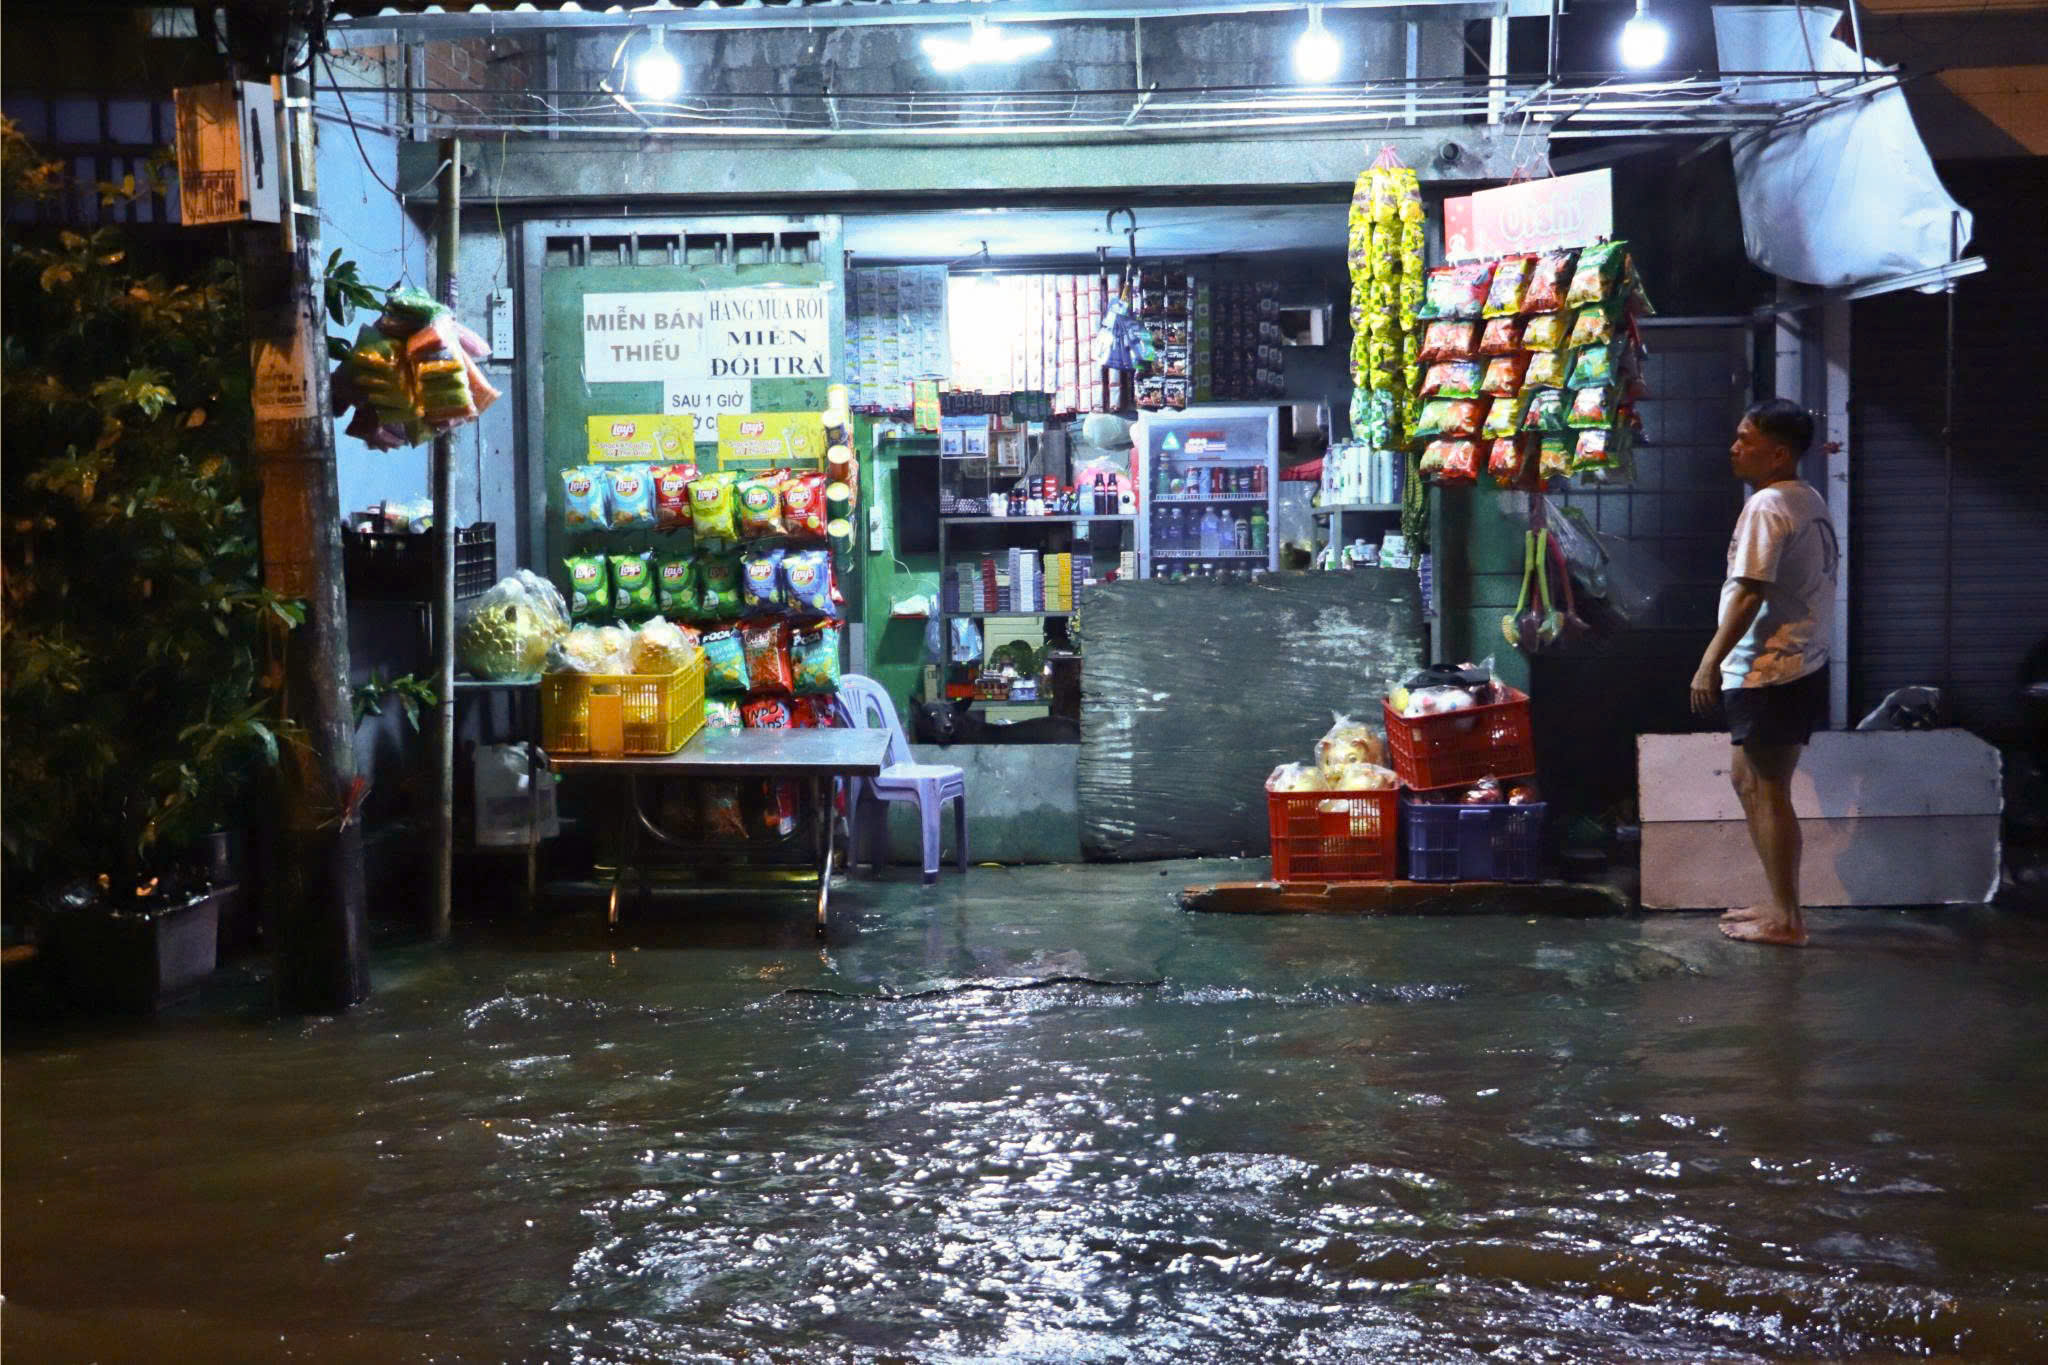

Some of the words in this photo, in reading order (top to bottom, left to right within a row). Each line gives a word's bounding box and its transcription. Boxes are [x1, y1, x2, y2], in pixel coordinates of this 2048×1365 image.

[758, 299, 793, 320] MUA
[585, 305, 646, 331] MIỄN
[654, 307, 704, 330] BÁN
[610, 338, 680, 362] THIẾU
[672, 394, 701, 408] SAU
[705, 394, 712, 408] 1
[717, 390, 744, 408] GIỜ
[612, 423, 636, 438] Lay's
[568, 480, 591, 492] Lay's
[615, 480, 638, 492] Lay's
[662, 480, 684, 492] Lay's
[696, 487, 718, 502] Lay's
[748, 491, 769, 505] Lay's
[789, 487, 811, 501] Lay's
[575, 566, 597, 579] Lay's
[620, 563, 641, 577] Lay's
[664, 566, 684, 577] Lay's
[749, 565, 772, 577] Lay's
[792, 568, 815, 581] Lay's
